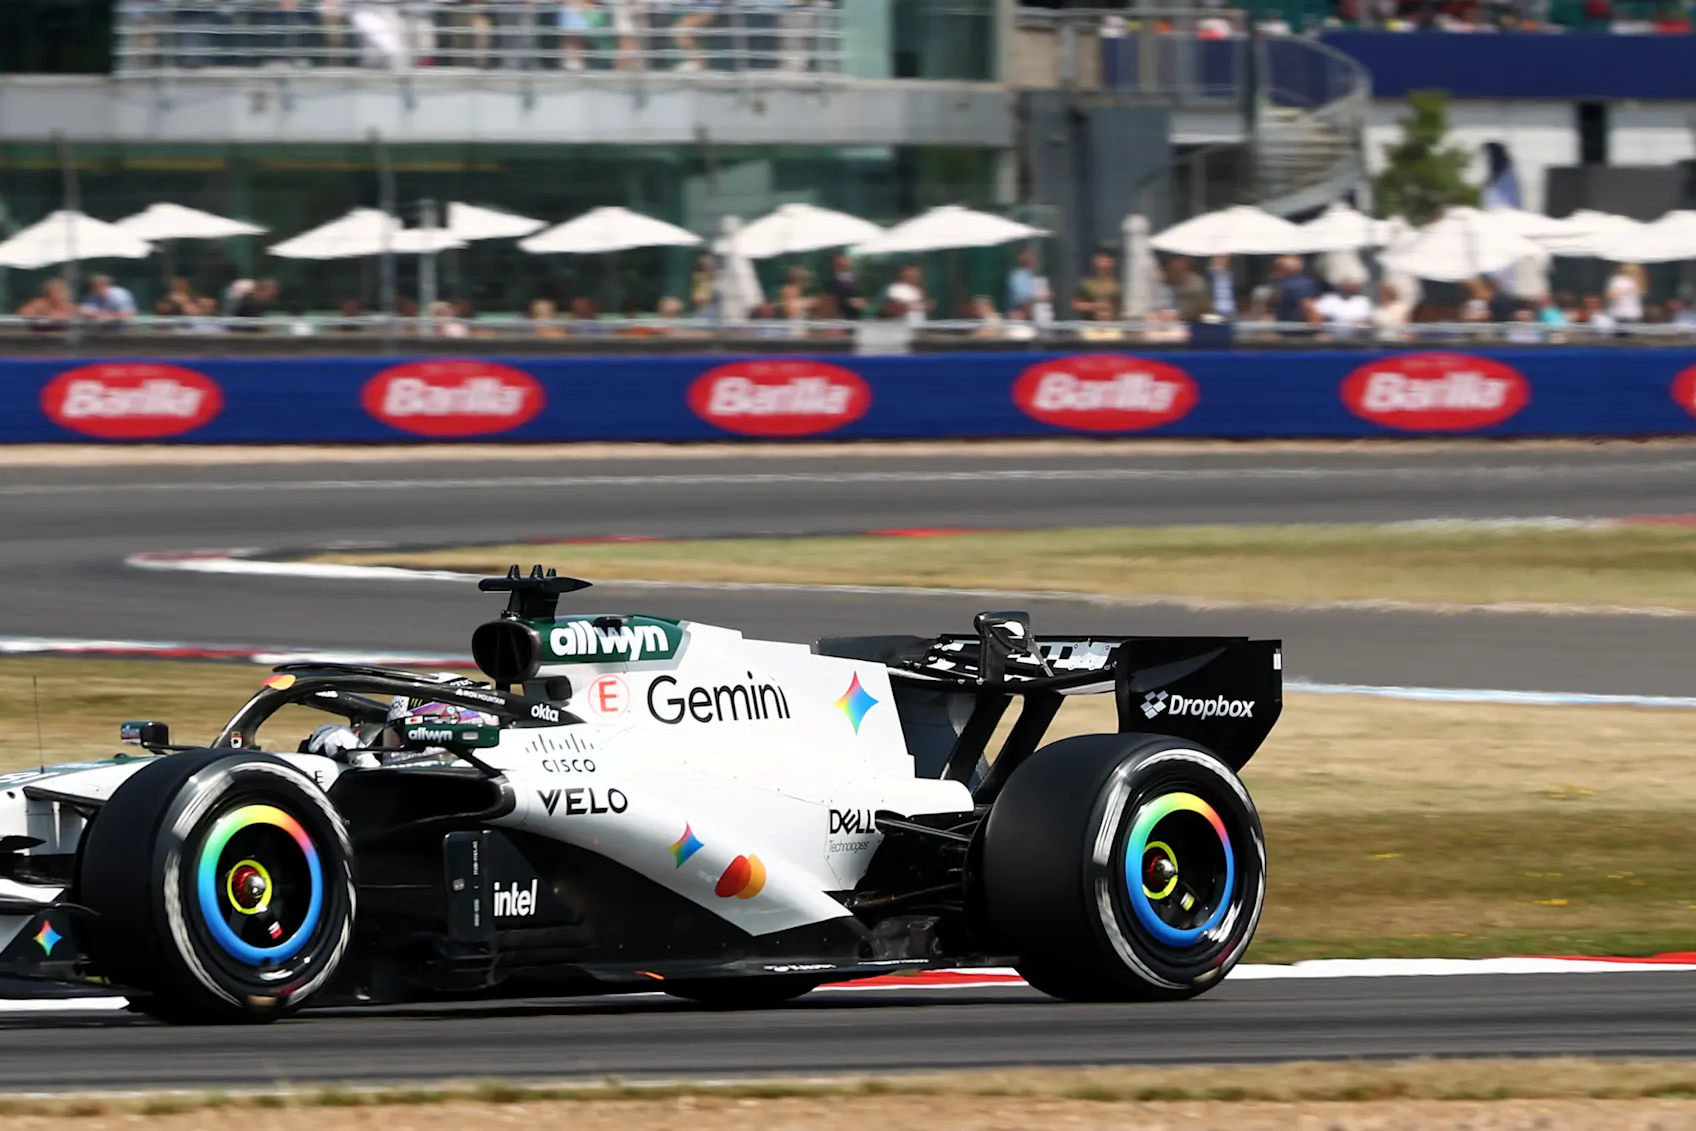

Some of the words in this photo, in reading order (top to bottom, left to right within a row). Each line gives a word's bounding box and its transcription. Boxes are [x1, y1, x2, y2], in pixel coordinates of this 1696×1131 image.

[62, 380, 203, 417] Barilla
[384, 378, 523, 415] Barilla
[709, 377, 851, 415] Barilla
[1033, 373, 1177, 411] Barilla
[1364, 372, 1508, 411] Barilla
[549, 620, 669, 661] allwyn
[531, 702, 560, 723] okta
[647, 671, 791, 725] Gemini
[1168, 694, 1255, 720] Dropbox
[408, 727, 453, 744] allwyn
[542, 759, 596, 773] CISCO
[536, 788, 629, 816] VELO
[830, 808, 876, 835] DELL
[493, 879, 538, 917] intel
